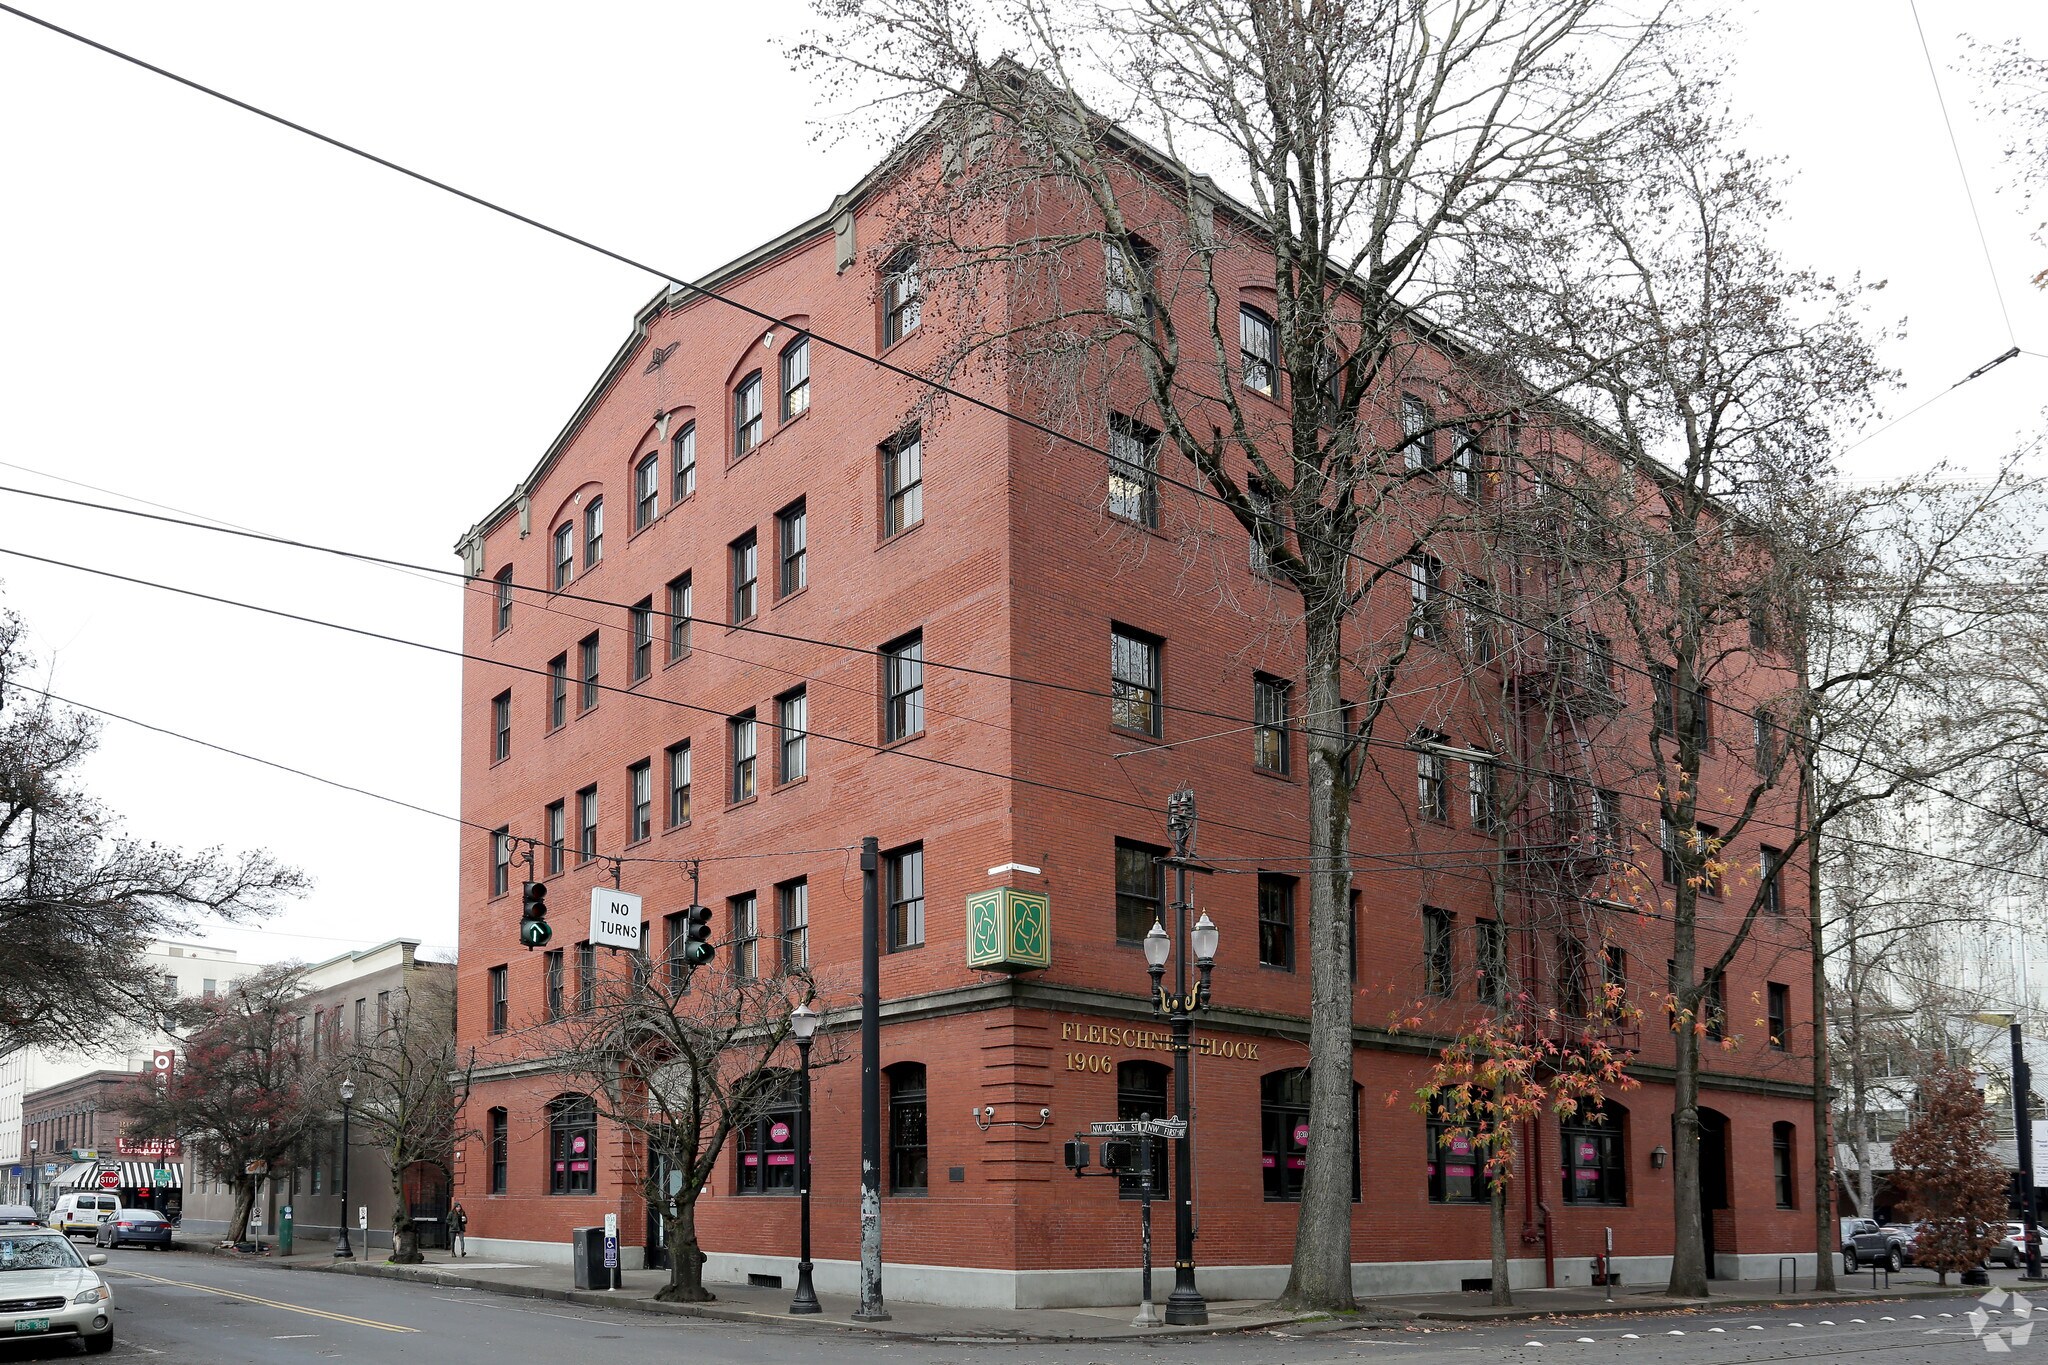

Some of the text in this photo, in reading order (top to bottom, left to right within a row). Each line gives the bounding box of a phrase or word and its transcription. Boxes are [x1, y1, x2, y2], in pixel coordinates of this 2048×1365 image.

[611, 902, 629, 916] NO
[600, 921, 637, 938] TURNS
[1061, 1022, 1259, 1061] FLEISCHNE BLOCK
[1065, 1052, 1112, 1074] 1906
[1105, 1124, 1126, 1132] COUCH
[1147, 1123, 1160, 1133] NW
[1296, 1130, 1309, 1139] jon
[100, 1176, 118, 1184] STOP
